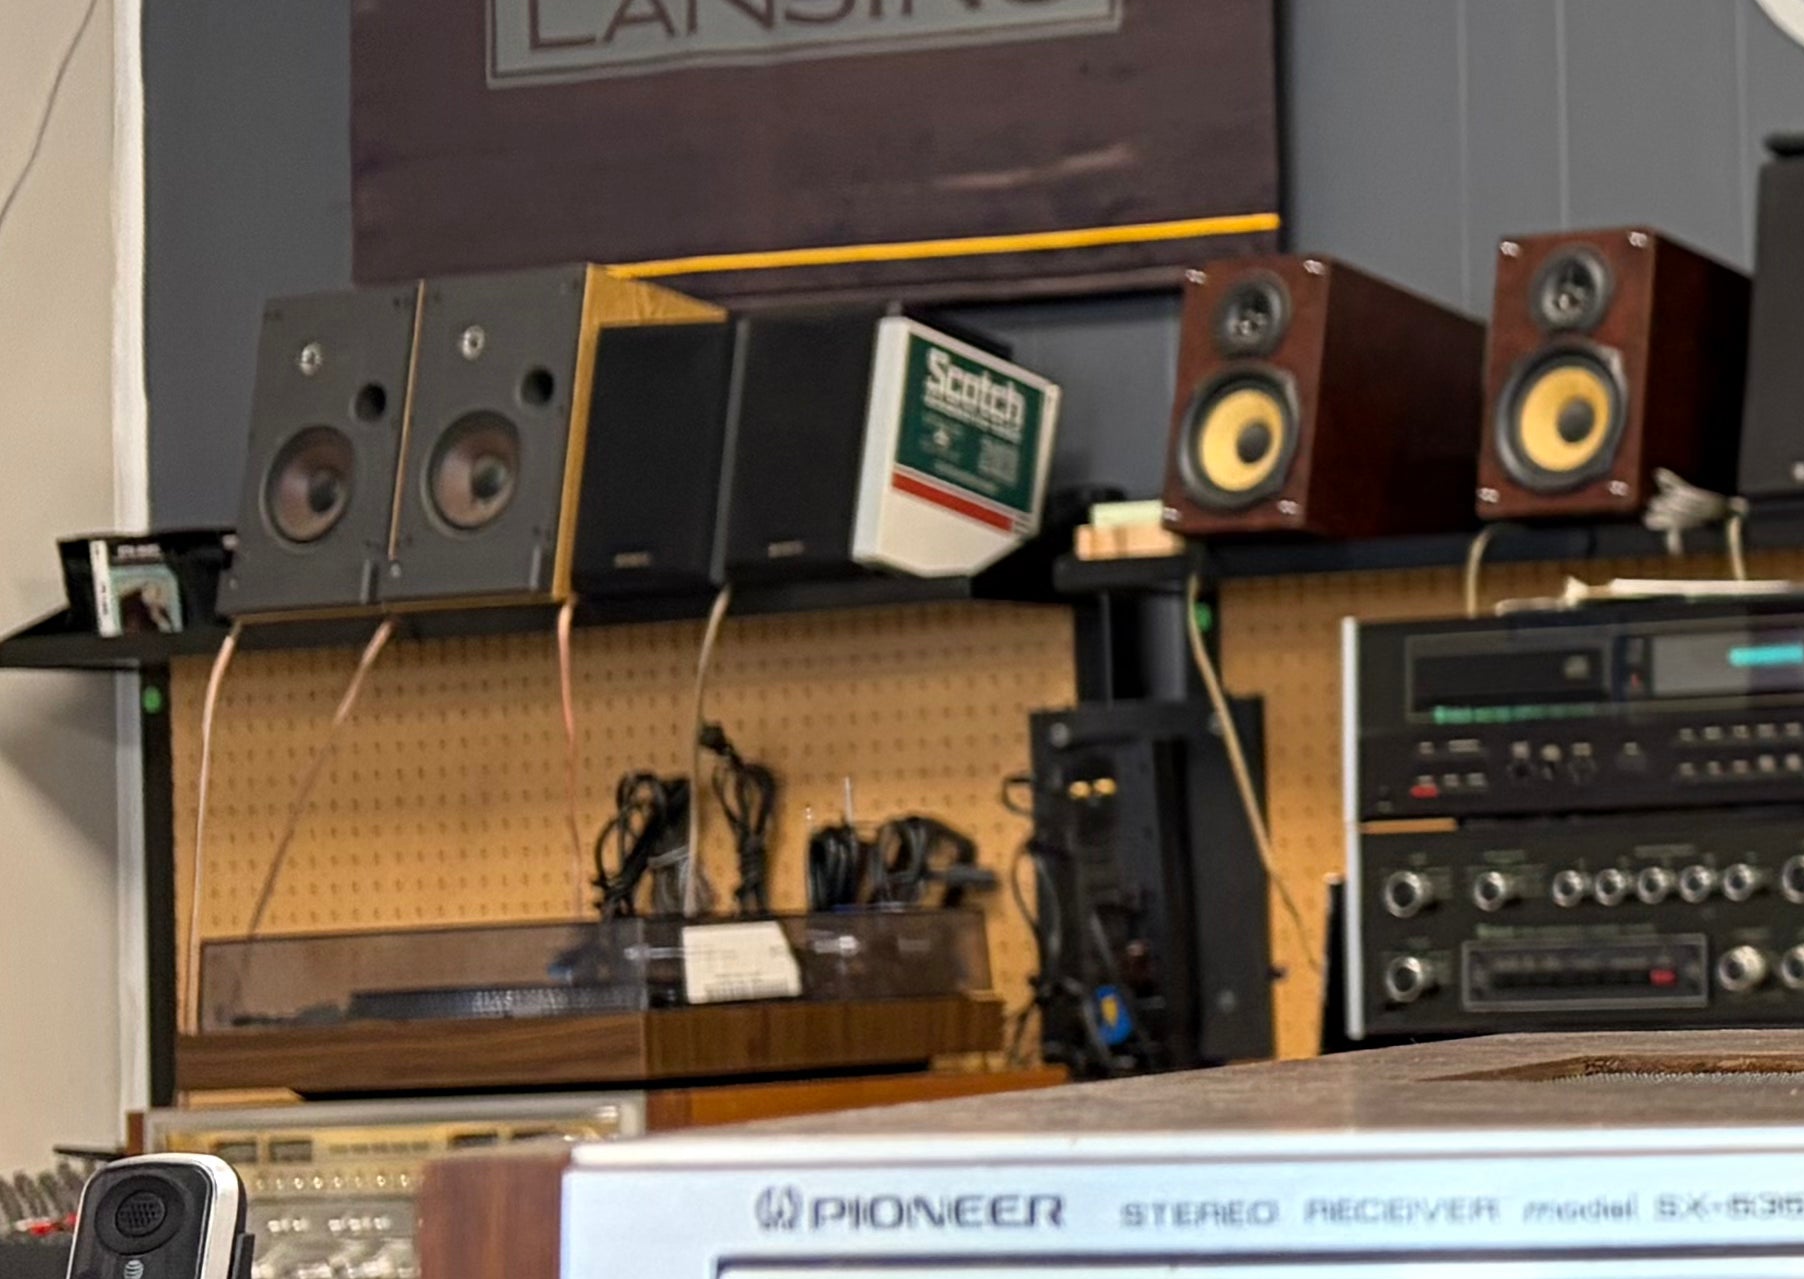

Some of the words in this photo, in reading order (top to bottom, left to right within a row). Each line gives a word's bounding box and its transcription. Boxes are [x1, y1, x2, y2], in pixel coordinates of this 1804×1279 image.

[926, 346, 1026, 432] Scotch
[811, 1193, 1064, 1231] PIONEER
[1119, 1197, 1281, 1228] STEREO
[1303, 1195, 1500, 1226] RECEIVER
[1522, 1194, 1637, 1223] model
